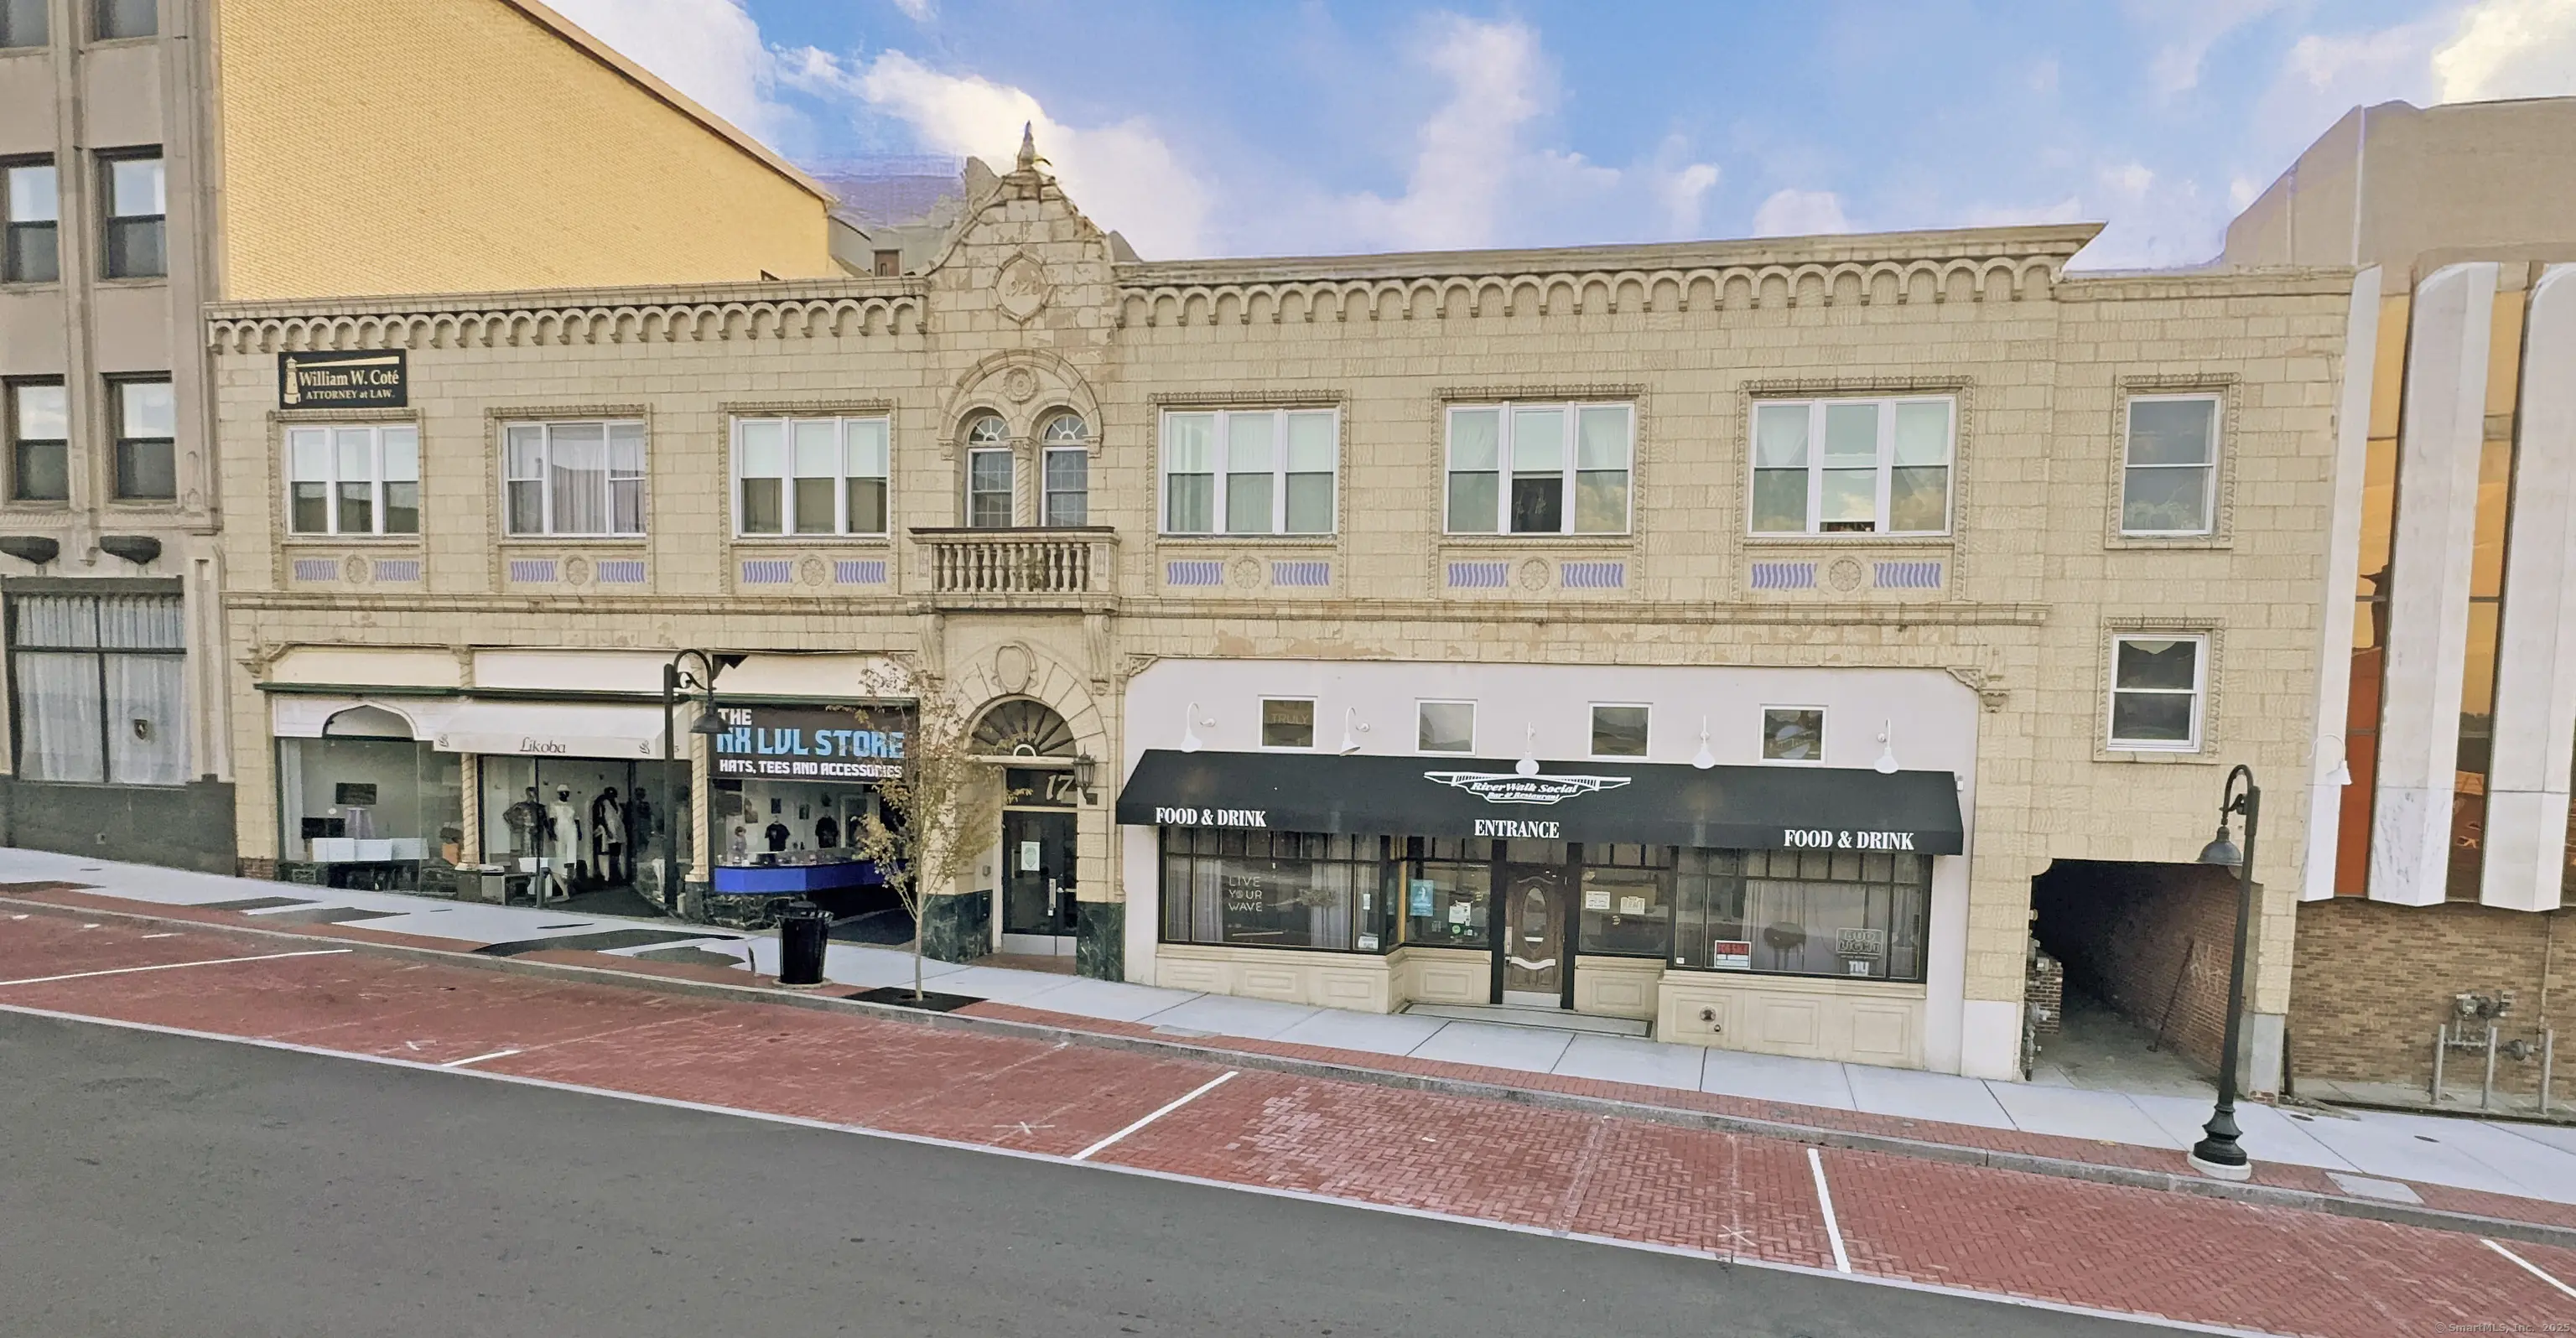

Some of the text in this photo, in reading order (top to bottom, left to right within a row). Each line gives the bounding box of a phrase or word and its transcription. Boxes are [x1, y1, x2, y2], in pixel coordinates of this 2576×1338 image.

[299, 369, 399, 386] William W. Coté
[306, 391, 356, 400] ATTORNEY
[359, 391, 368, 399] at
[717, 708, 752, 726] THE
[1270, 713, 1309, 724] TRULY
[519, 736, 566, 754] Likoba
[716, 727, 752, 754] NX
[814, 729, 905, 759] STORE
[719, 760, 903, 779] HATS, TEES AND ACCESSORIES
[1538, 784, 1579, 793] Social
[1514, 791, 1560, 801] Restaurant
[1156, 806, 1267, 827] FOOD & DRINK
[1474, 819, 1560, 839] ENTRANCE
[1784, 829, 1914, 850] FOOD & DRINK
[1229, 875, 1261, 887] LIVE
[1228, 889, 1263, 900] YOUR
[1228, 901, 1263, 912] WAVE
[1844, 930, 1876, 941] BUD
[1838, 940, 1881, 952] LIGHT
